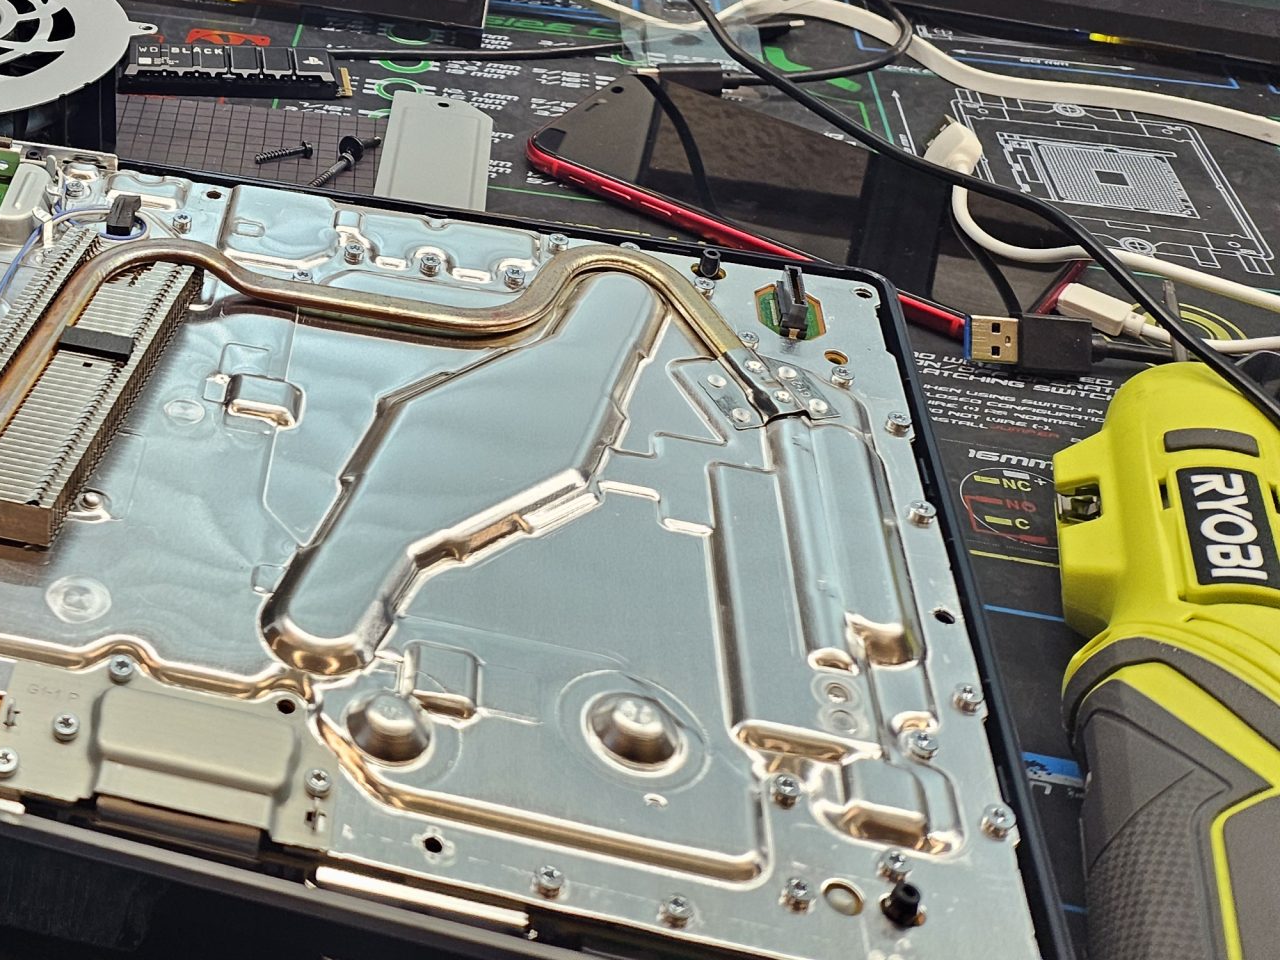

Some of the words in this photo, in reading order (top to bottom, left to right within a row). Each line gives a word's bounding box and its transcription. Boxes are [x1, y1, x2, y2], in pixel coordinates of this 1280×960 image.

[918, 368, 1026, 389] ATCHING
[924, 391, 982, 405] LOSED
[966, 390, 1016, 402] USING
[1021, 398, 1083, 413] SWITCH
[931, 416, 989, 430] NSTALL
[948, 409, 982, 420] NOT
[985, 416, 1028, 427] WIRE
[1002, 478, 1032, 491] NC
[1006, 499, 1037, 513] NO
[1014, 518, 1030, 530] C
[1190, 473, 1268, 581] RYOBI
